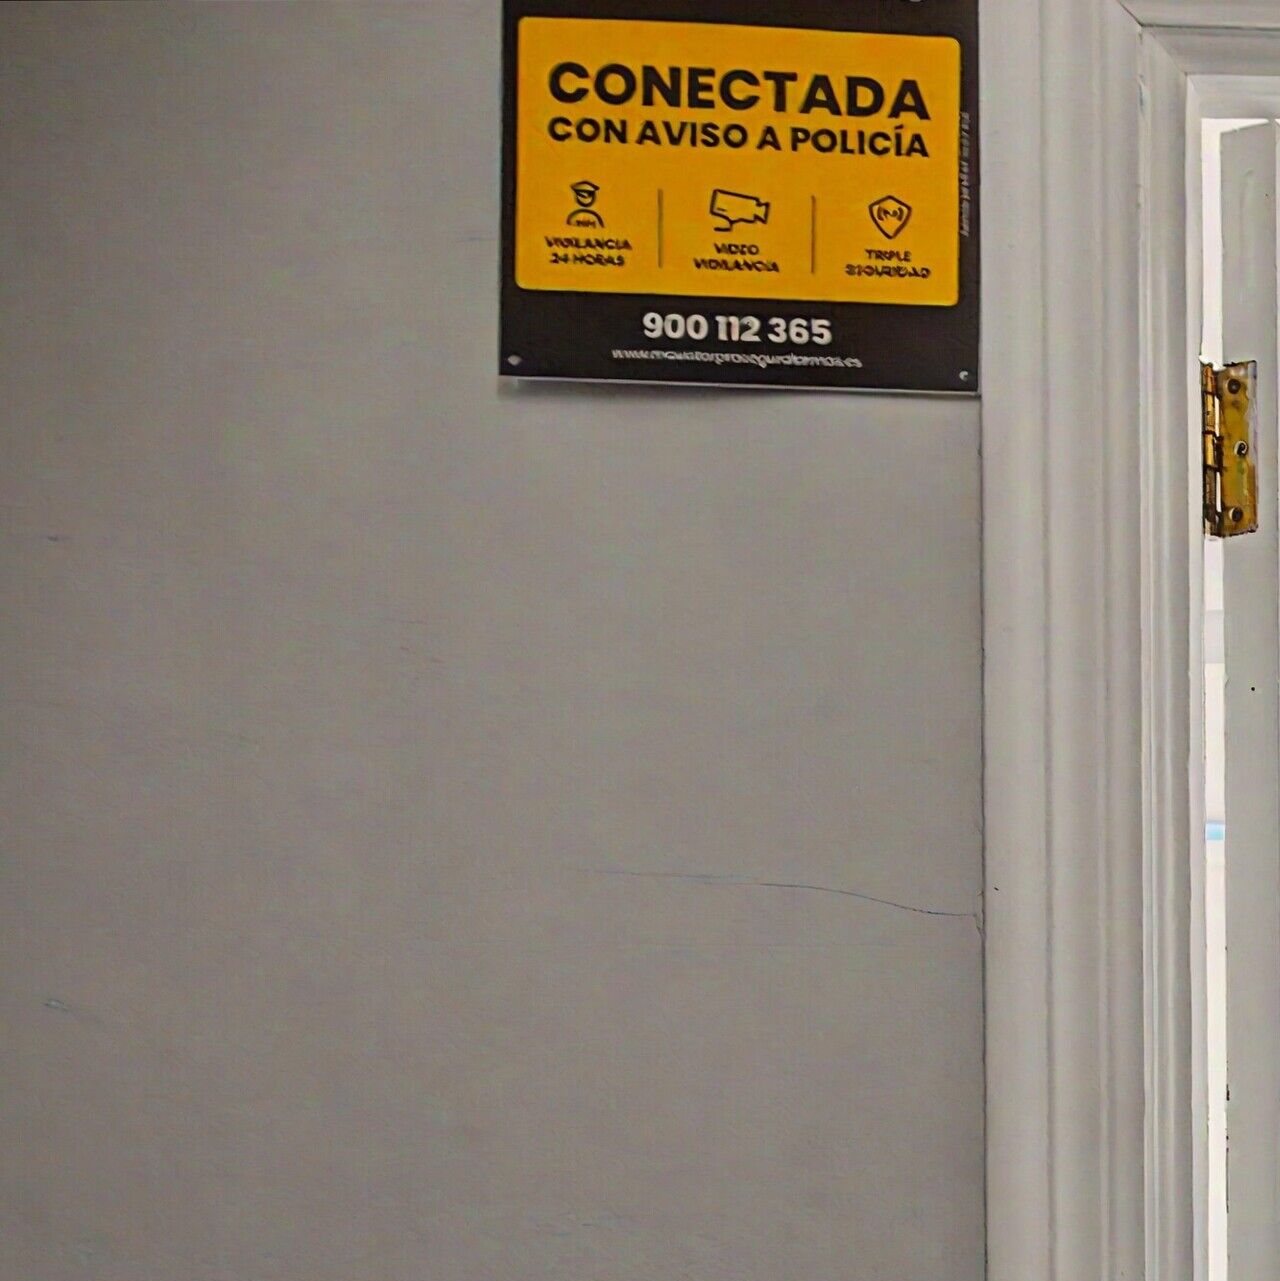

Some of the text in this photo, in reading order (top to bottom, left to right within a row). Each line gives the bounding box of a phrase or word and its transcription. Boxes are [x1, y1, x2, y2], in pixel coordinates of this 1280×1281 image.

[549, 61, 931, 120] CONECTADA
[548, 116, 929, 157] CON AVISO A POLICÍA
[545, 236, 632, 250] VIGILANCIA
[714, 243, 759, 256] VIDEO
[550, 253, 625, 267] 24 HORAS
[865, 248, 911, 262] TRIPLE
[694, 258, 779, 272] VIGILANCIA
[642, 312, 832, 345] 900 112 365
